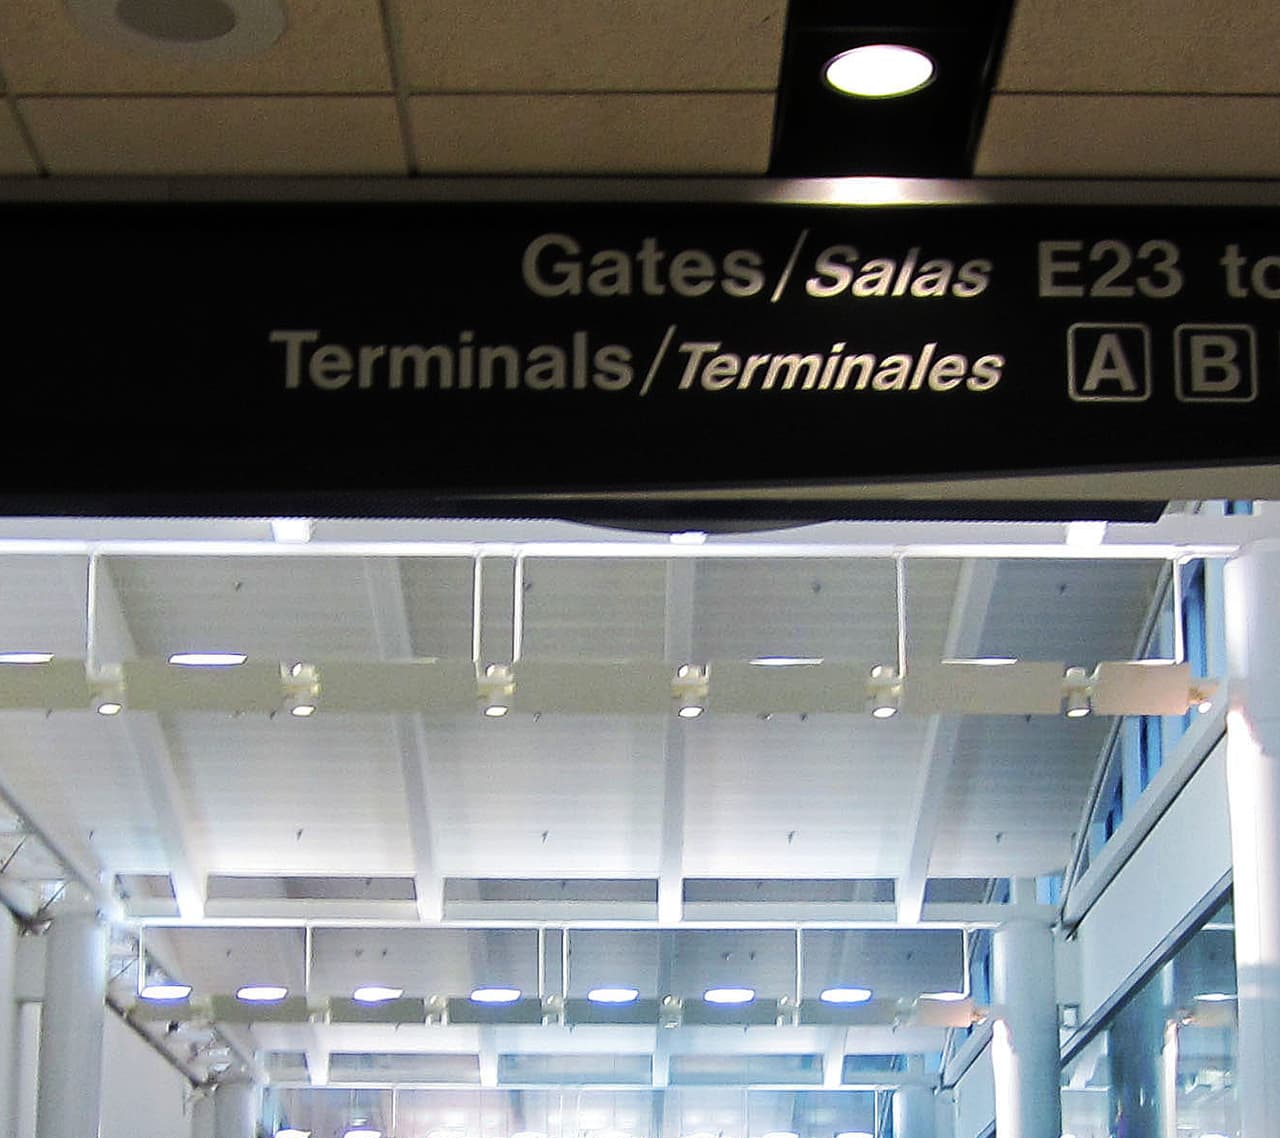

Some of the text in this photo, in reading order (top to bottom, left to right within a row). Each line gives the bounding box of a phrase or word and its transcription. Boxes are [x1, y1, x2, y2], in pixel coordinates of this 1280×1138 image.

[1038, 239, 1184, 299] E23
[1082, 333, 1136, 392] A
[1190, 334, 1241, 393] B
